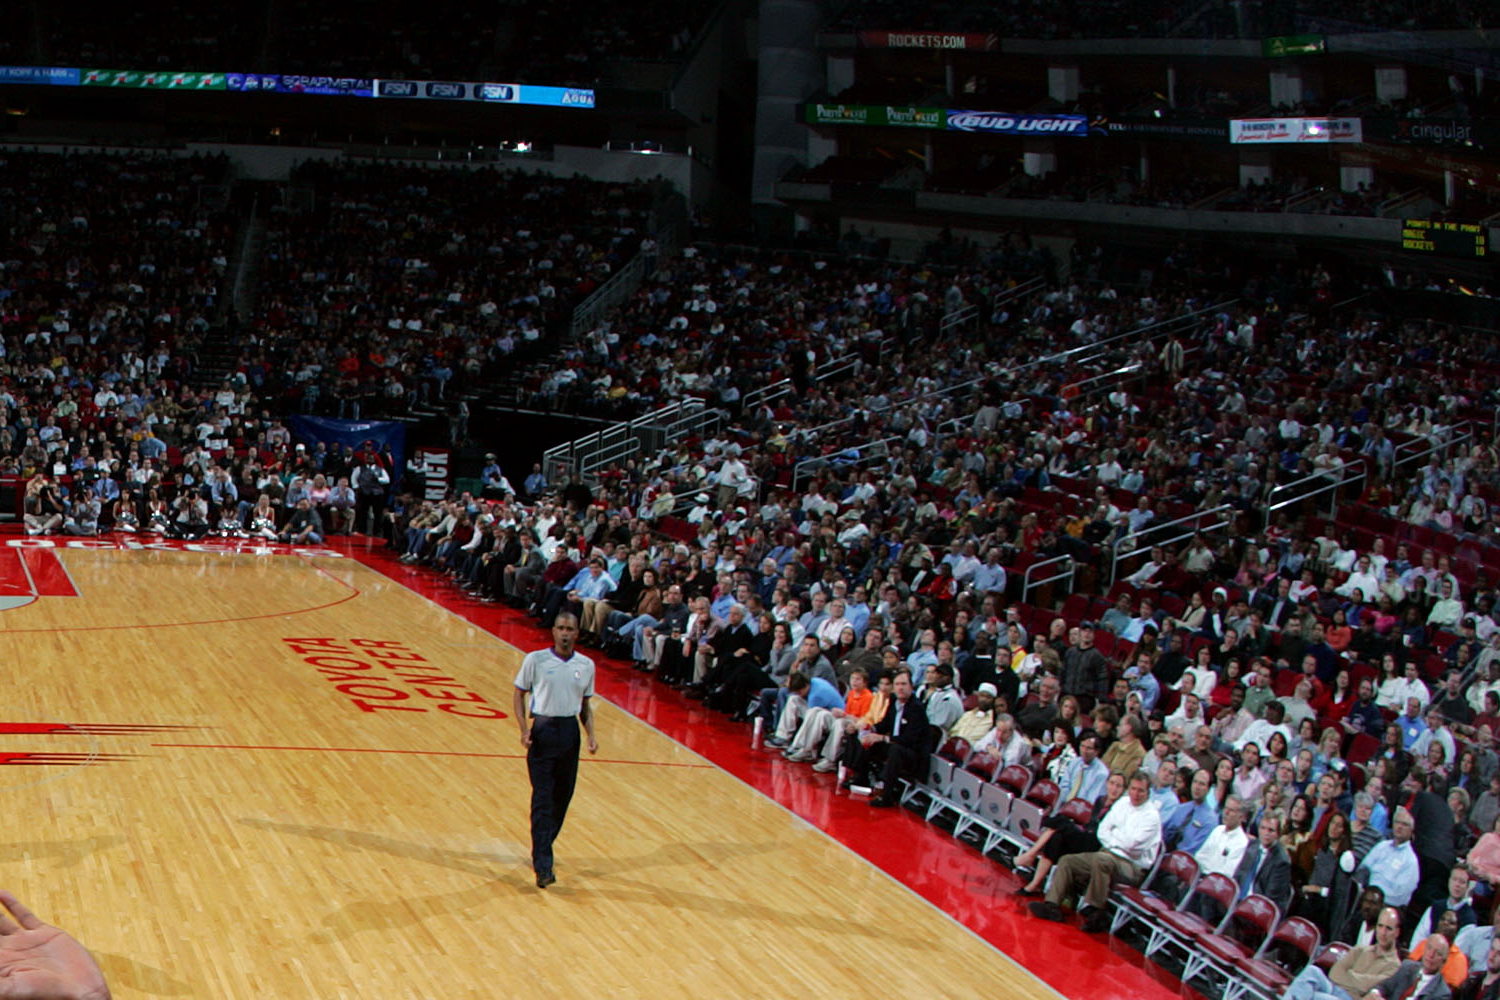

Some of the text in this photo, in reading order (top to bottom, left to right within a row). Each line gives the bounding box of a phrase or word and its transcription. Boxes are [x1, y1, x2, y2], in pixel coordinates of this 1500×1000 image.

[887, 32, 966, 49] ROCKETS.COM
[384, 82, 412, 95] FSN
[431, 84, 460, 96] FSN
[479, 85, 508, 98] FSN
[965, 115, 1082, 132] BUD LIGHT
[1411, 122, 1473, 143] cingular
[423, 451, 449, 500] KICK
[281, 637, 429, 713] TOYOTA
[349, 638, 509, 720] CENTER
